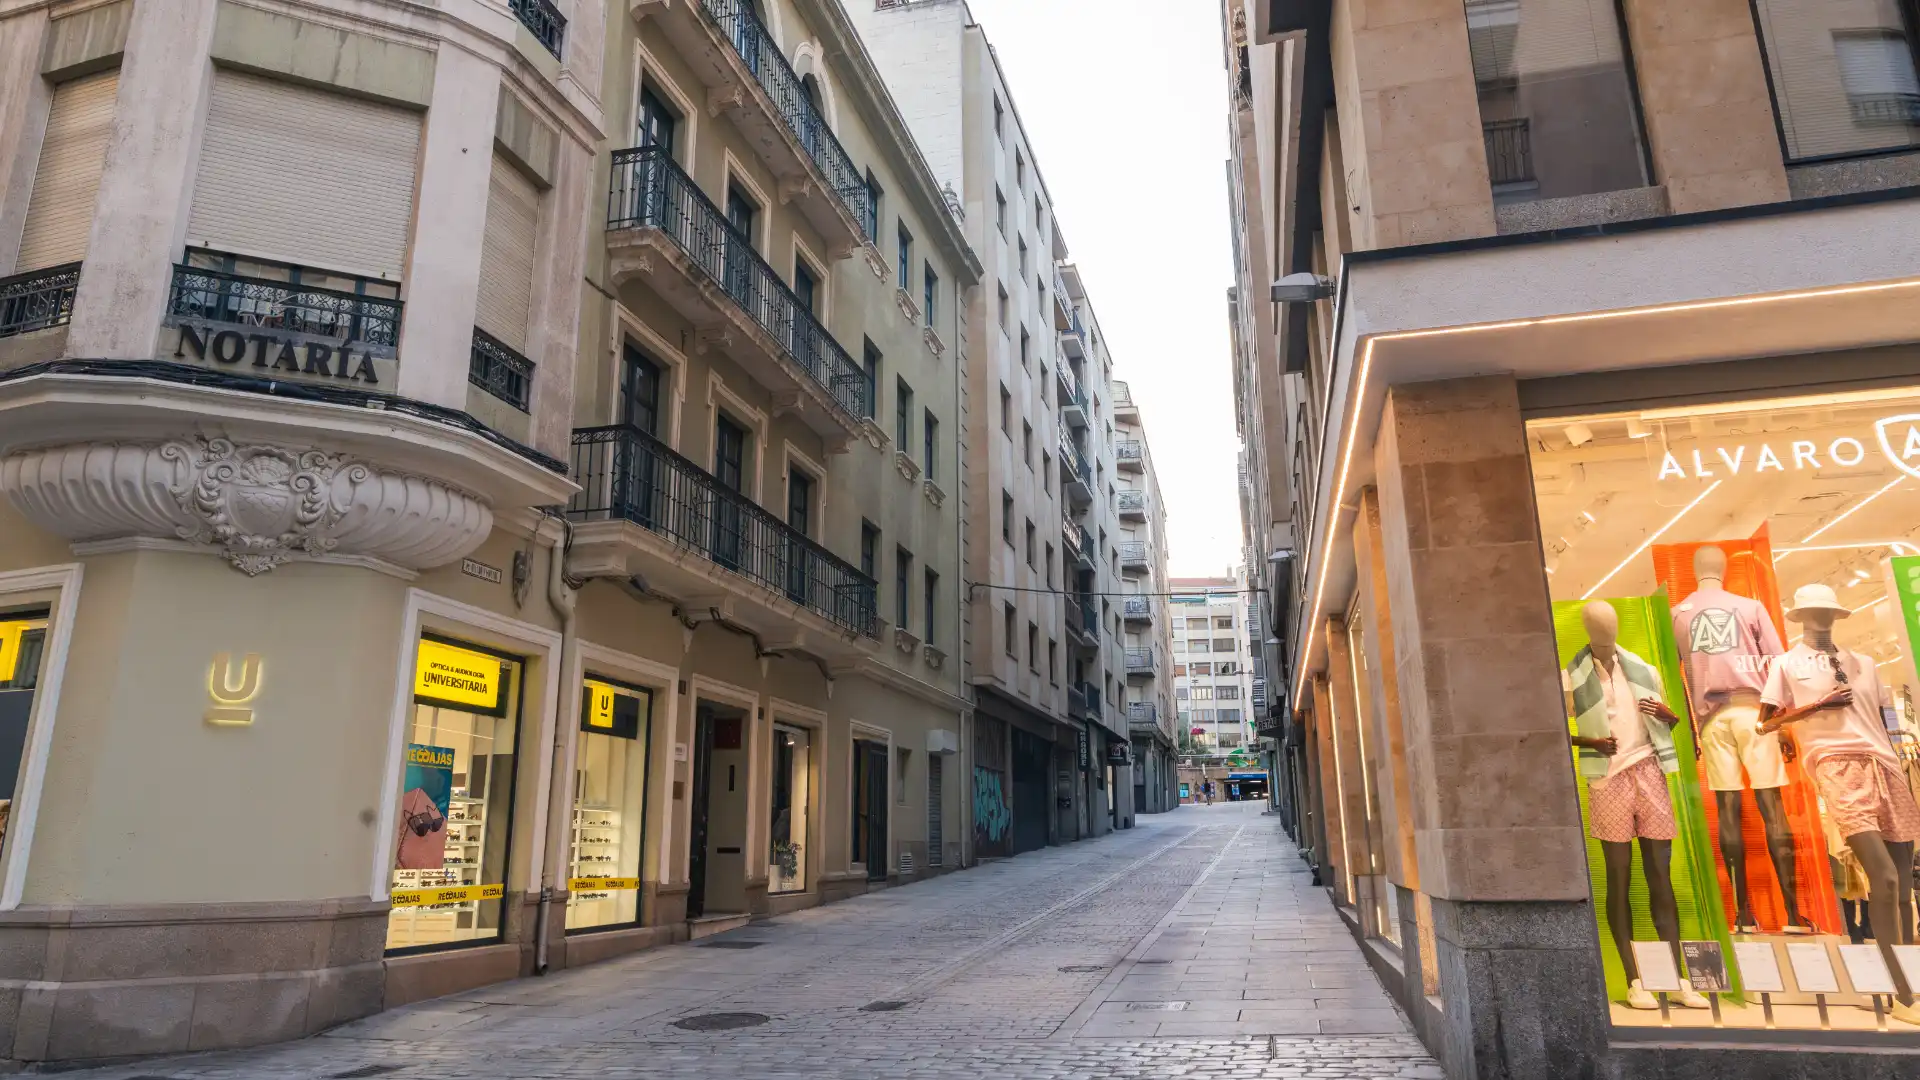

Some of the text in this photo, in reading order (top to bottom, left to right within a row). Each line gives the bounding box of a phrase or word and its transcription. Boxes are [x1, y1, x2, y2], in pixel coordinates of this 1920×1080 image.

[174, 323, 379, 383] NOTARÍA
[1657, 437, 1865, 481] ALVARO
[210, 652, 262, 704] U
[423, 671, 488, 694] UNIVERSITARIA
[601, 694, 609, 711] U
